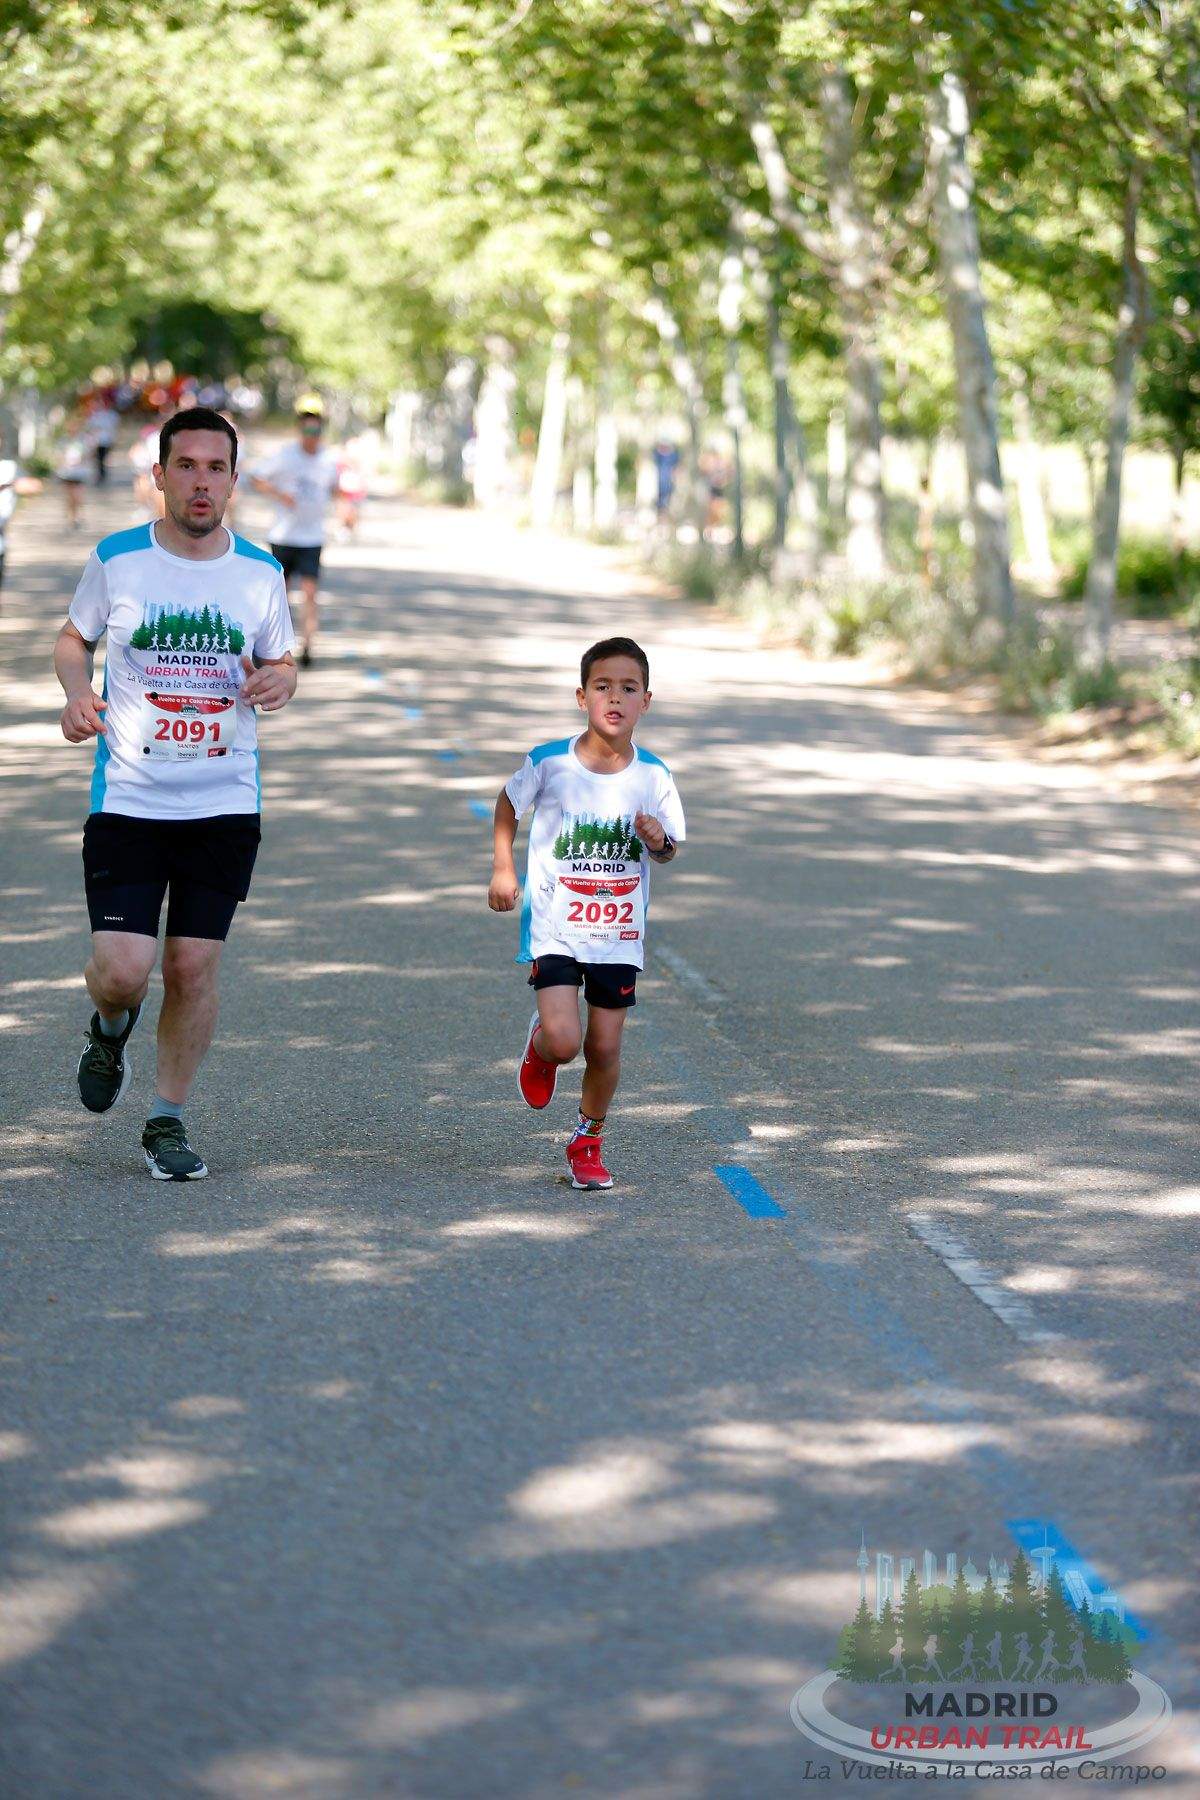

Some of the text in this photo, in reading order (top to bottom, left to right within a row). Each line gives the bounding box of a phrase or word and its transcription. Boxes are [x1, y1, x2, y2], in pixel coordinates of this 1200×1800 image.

[157, 654, 218, 666] MADRID
[145, 666, 229, 679] URBAN TRAIL
[127, 672, 136, 682] La
[137, 676, 164, 688] Vuelta
[174, 680, 182, 688] la
[184, 681, 207, 689] Casa
[209, 681, 220, 689] de
[154, 718, 220, 742] 2091
[572, 863, 626, 873] MADRID
[567, 901, 634, 924] 2092
